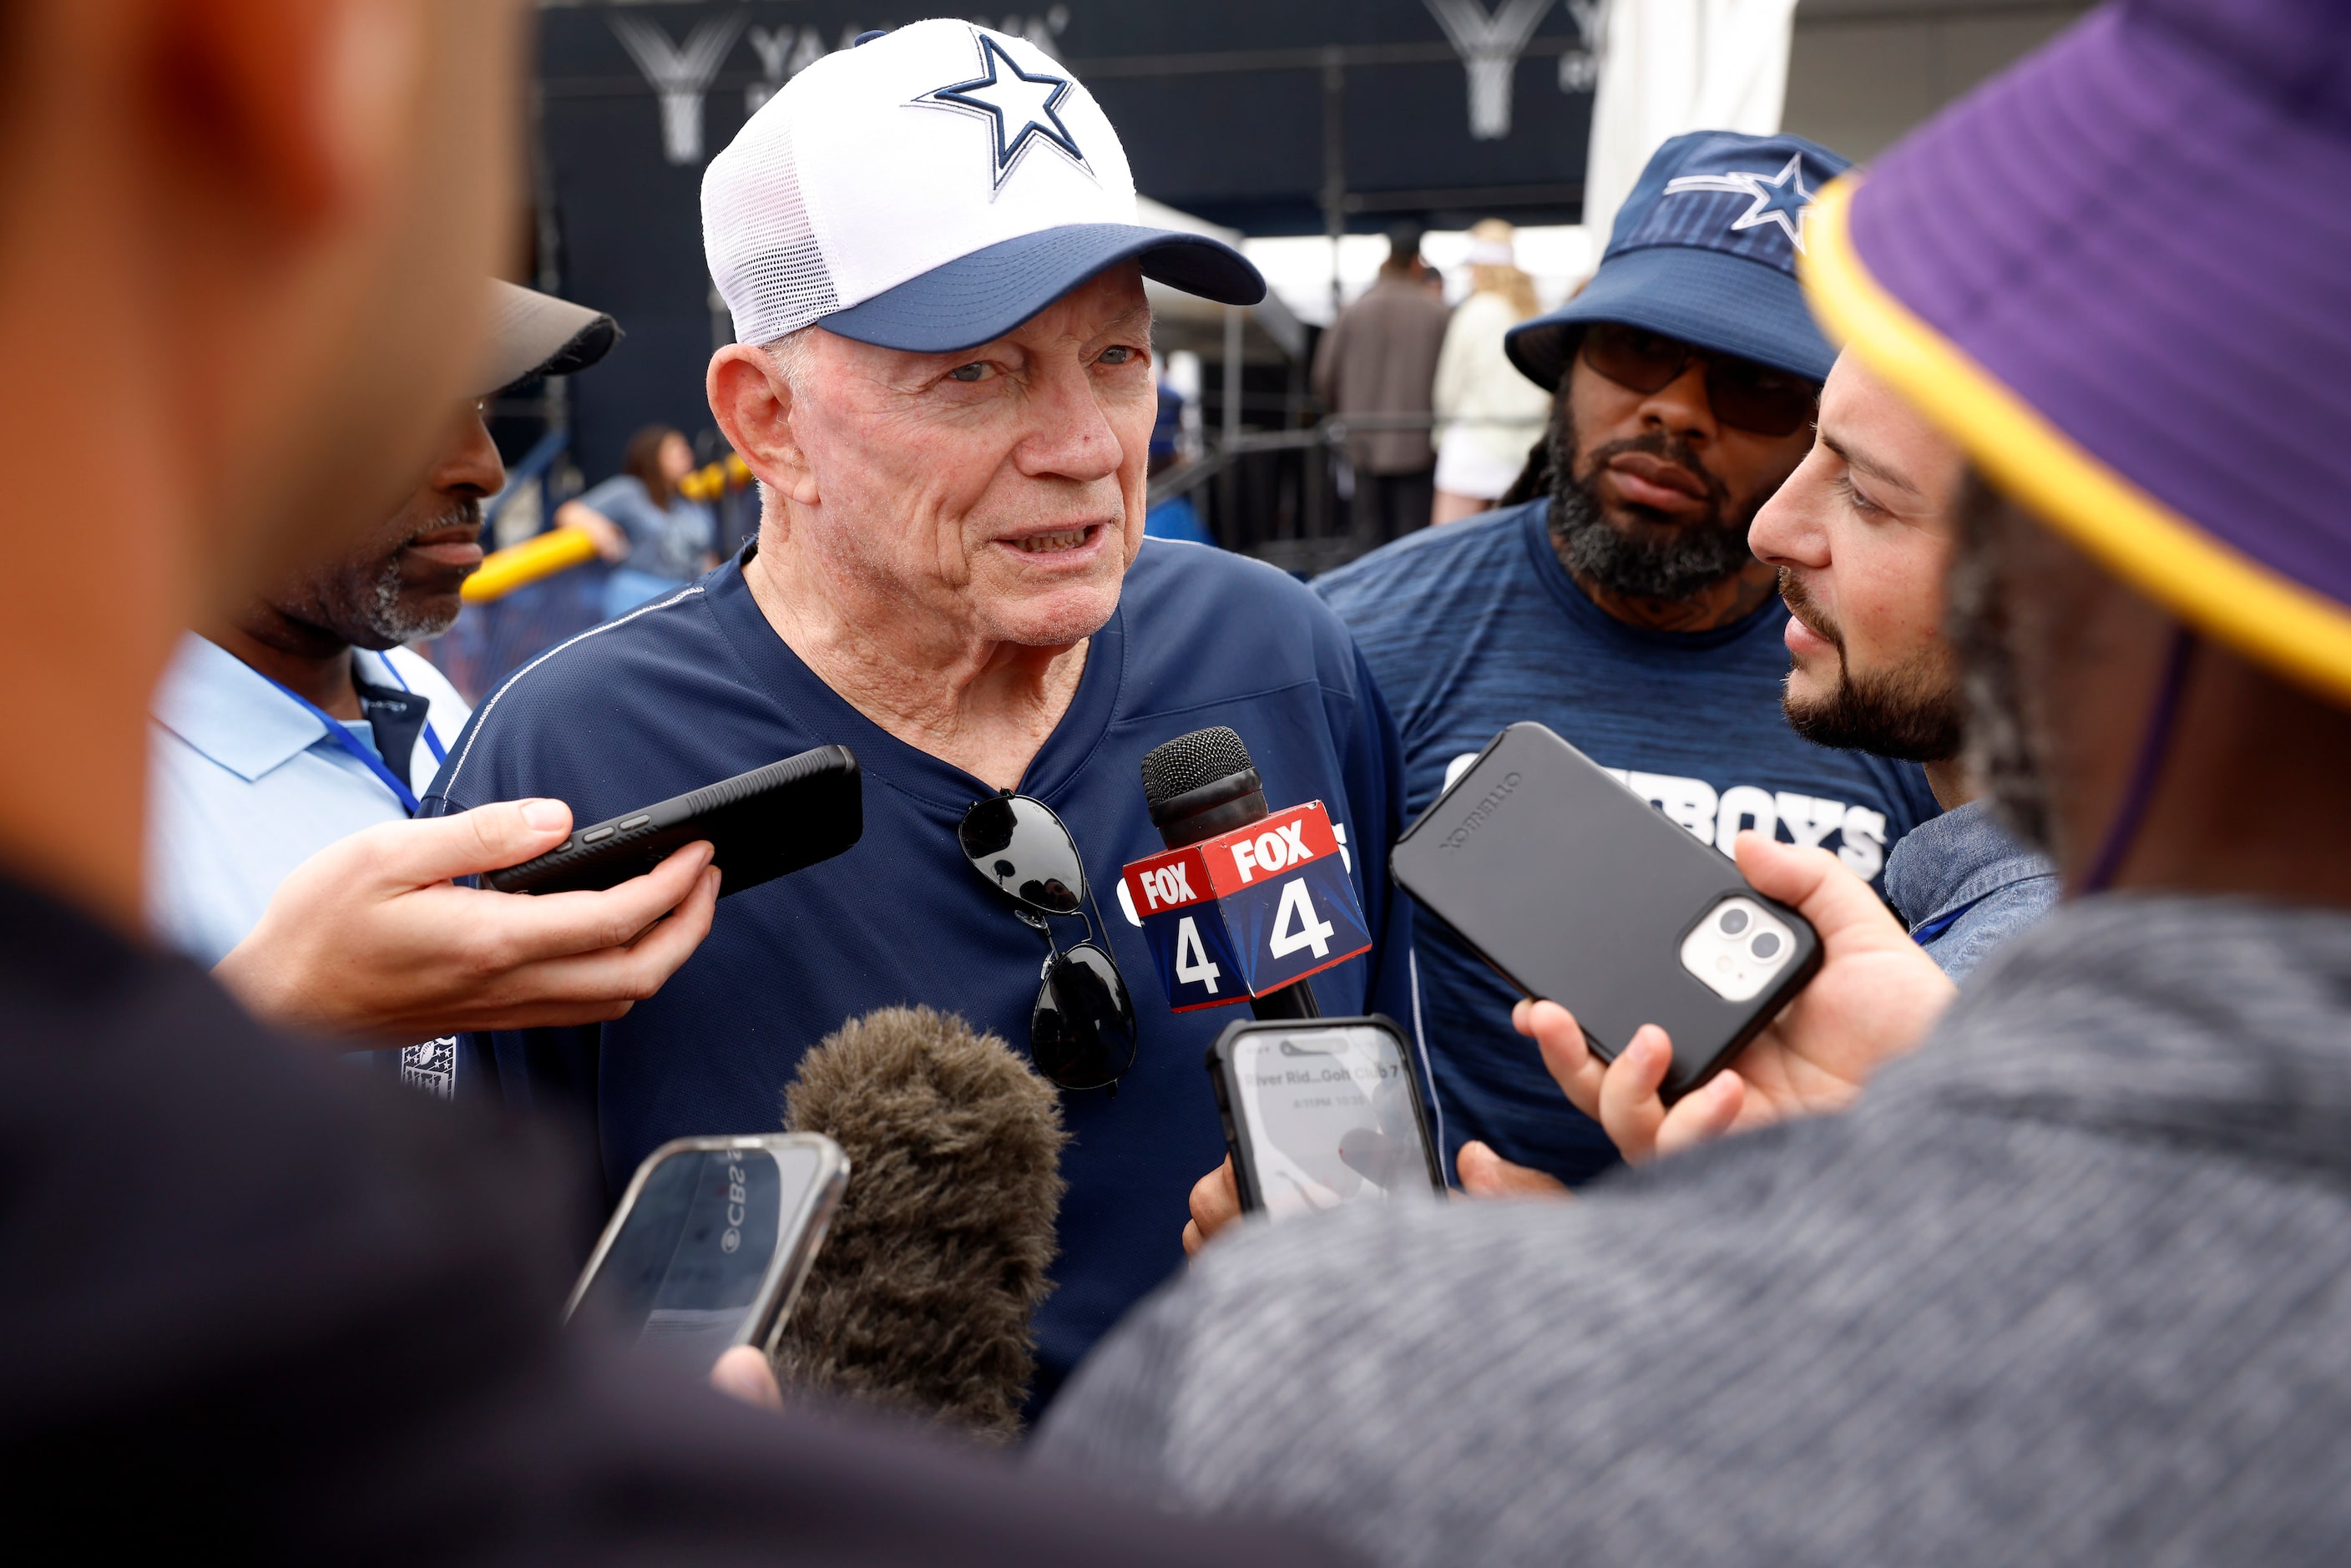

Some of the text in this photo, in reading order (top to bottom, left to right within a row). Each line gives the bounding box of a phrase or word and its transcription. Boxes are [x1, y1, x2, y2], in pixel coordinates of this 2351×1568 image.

[1140, 861, 1197, 910] FOX
[1230, 820, 1314, 883] FOX
[1269, 878, 1335, 959] 4
[1176, 916, 1221, 994] 4
